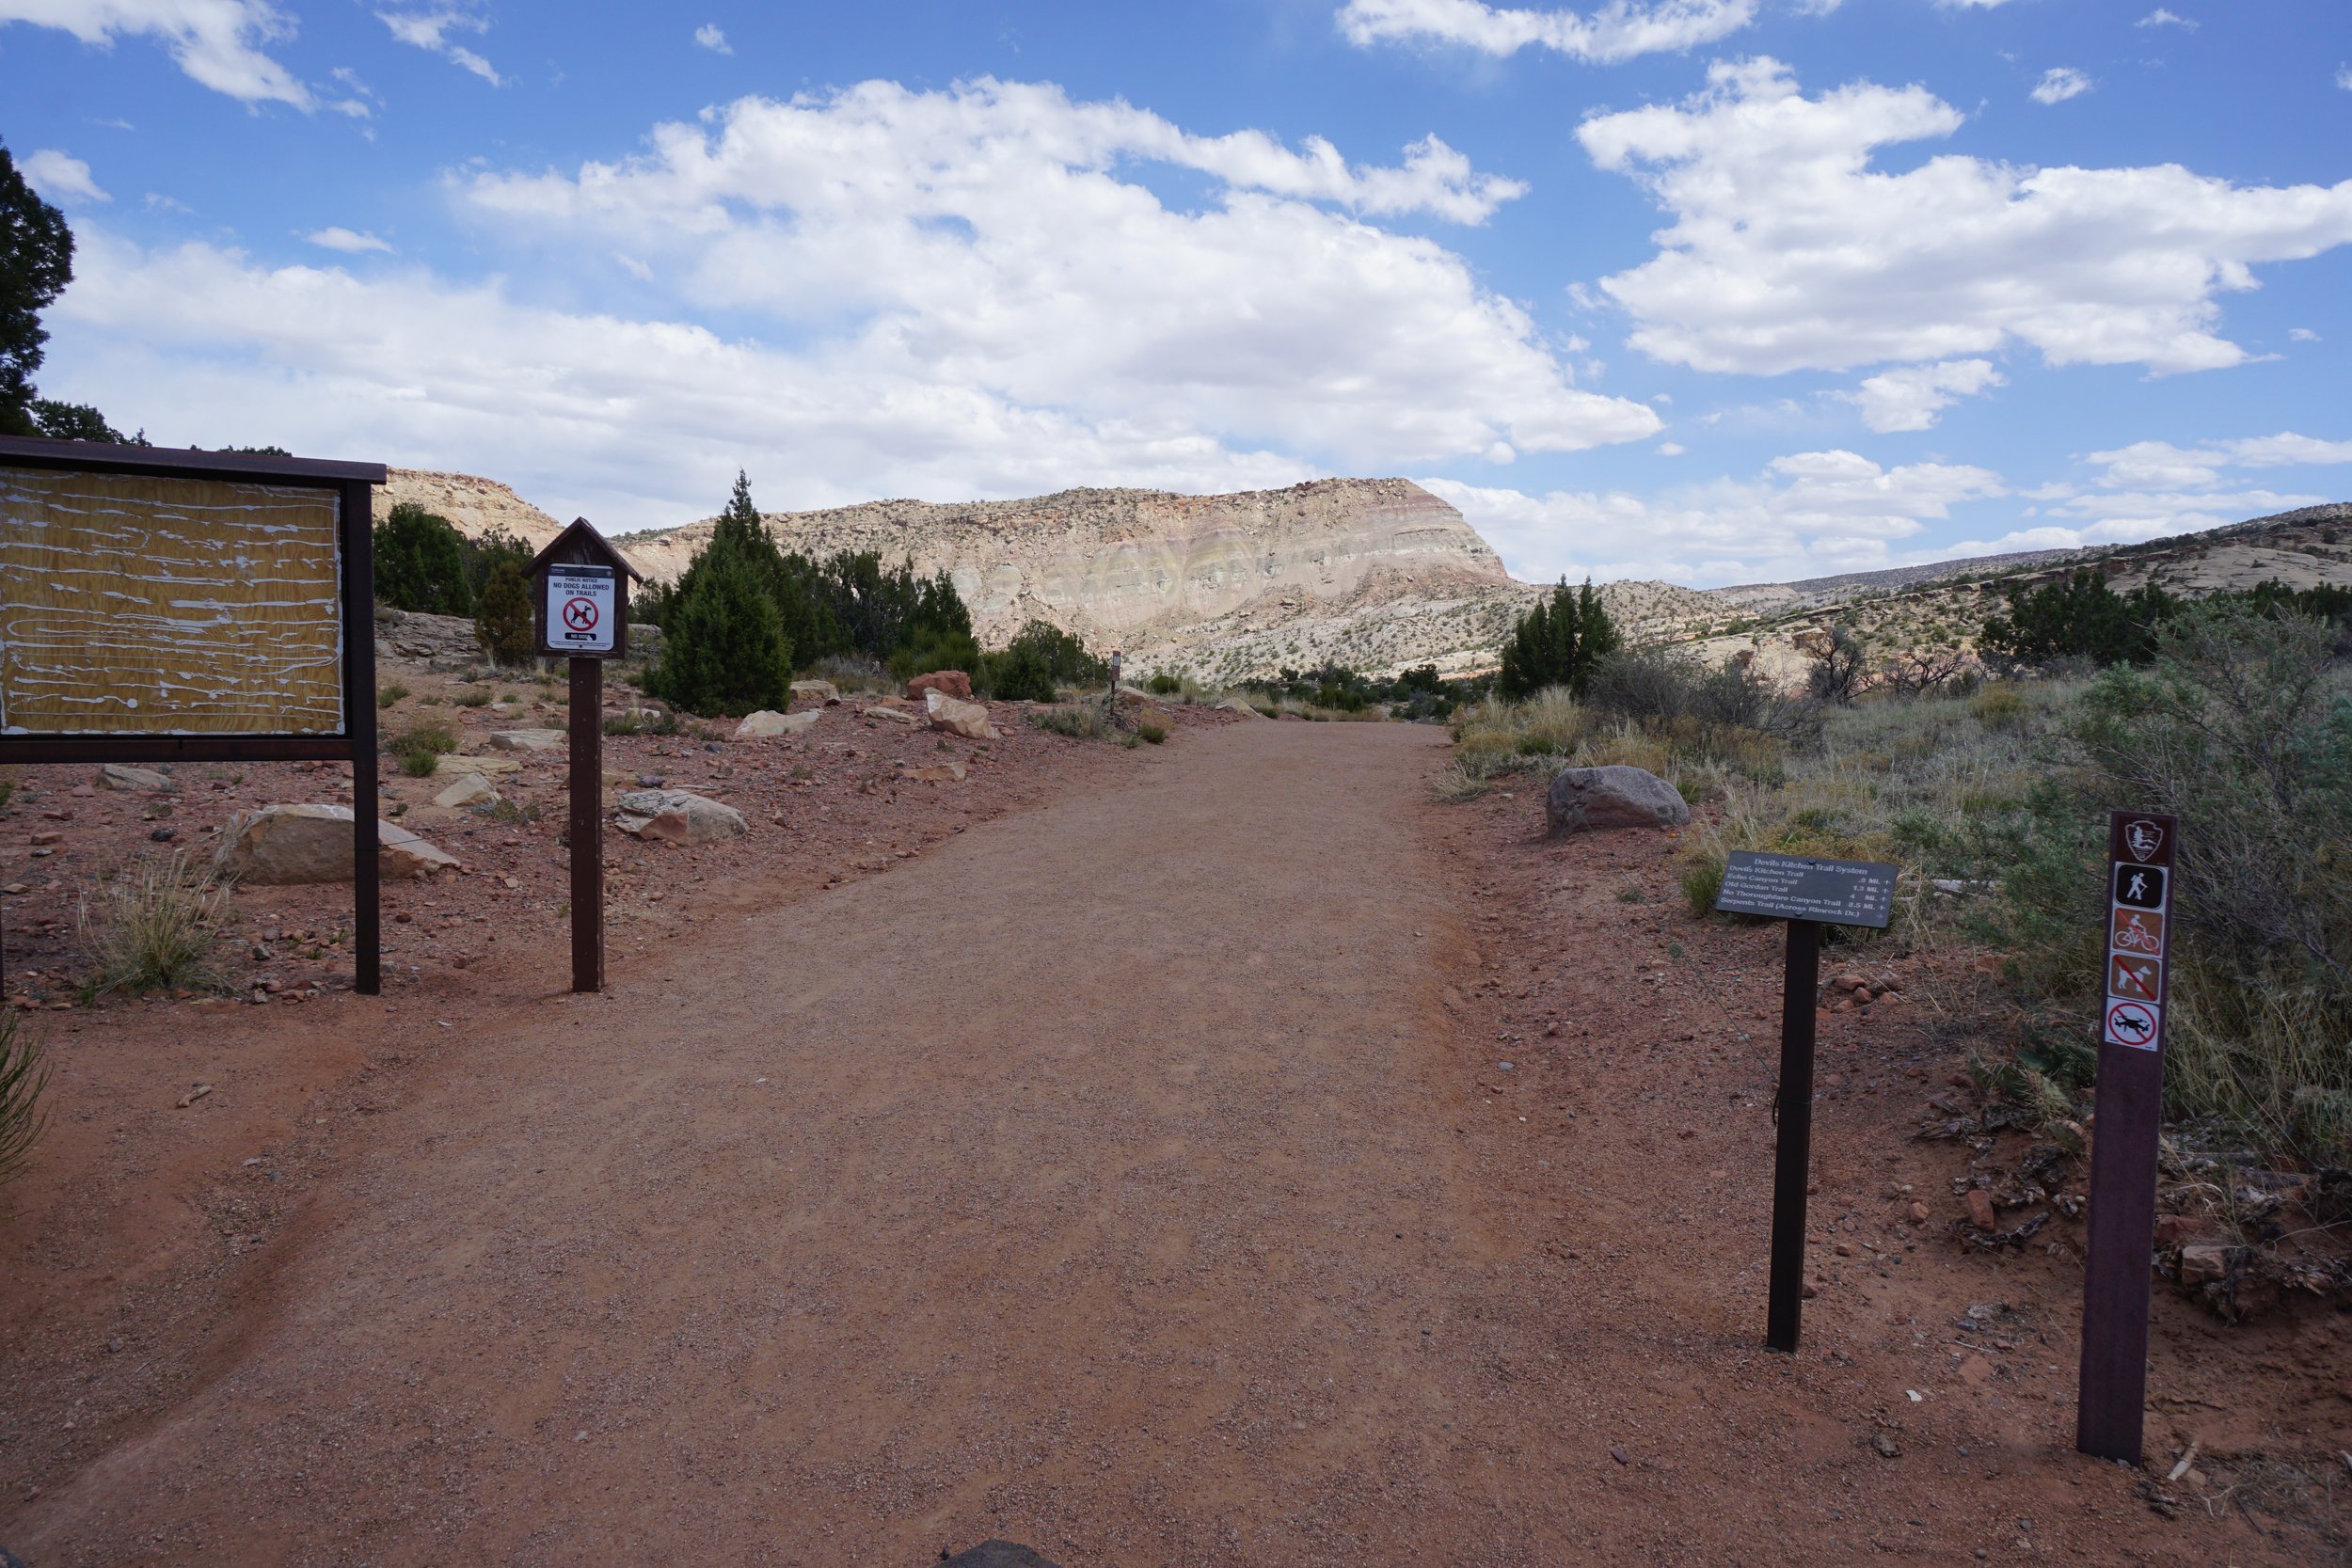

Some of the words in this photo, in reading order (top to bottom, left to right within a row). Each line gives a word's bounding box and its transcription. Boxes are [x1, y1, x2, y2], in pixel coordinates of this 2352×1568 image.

[1755, 858, 1780, 867] Devils
[1781, 861, 1813, 870] Kitchen
[1836, 866, 1867, 875] System
[1749, 875, 1779, 884] Canyon
[1737, 890, 1788, 901] Thoroughfare
[1790, 896, 1821, 904] Canyon
[1720, 897, 1755, 905] Serpents
[1756, 900, 1774, 909] Trail
[1775, 903, 1806, 912] (Across
[1808, 906, 1842, 915] Rimrock
